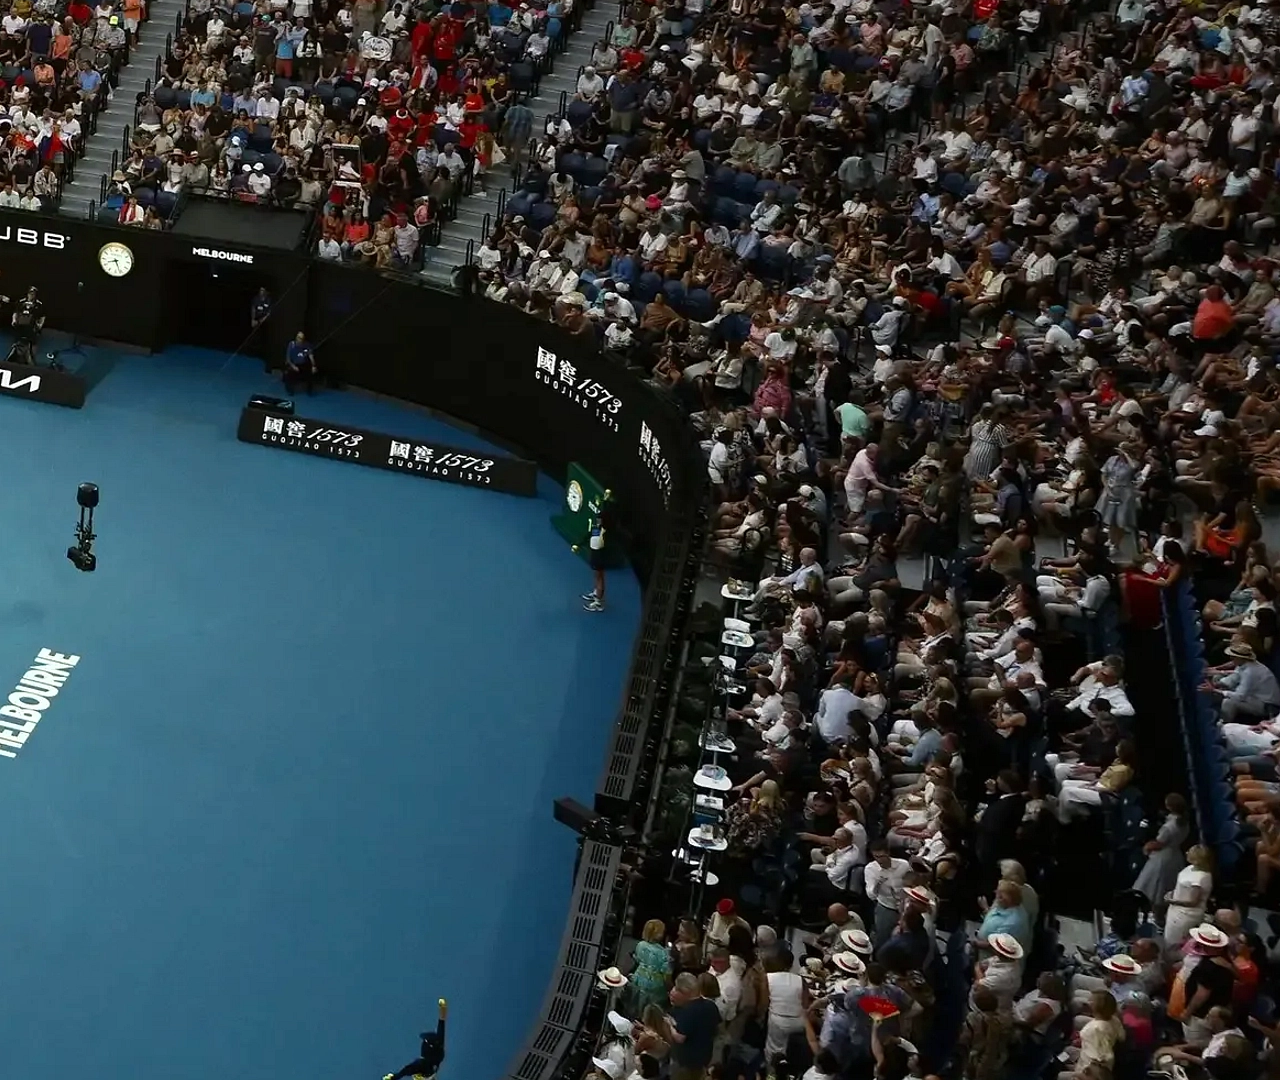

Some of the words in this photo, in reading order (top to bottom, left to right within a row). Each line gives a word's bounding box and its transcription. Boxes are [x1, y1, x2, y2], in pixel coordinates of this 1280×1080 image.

[192, 247, 254, 264] MELBOURNE
[535, 370, 589, 409] GUOJIAO
[595, 408, 619, 433] 1573
[261, 433, 320, 450] GUOJIAO
[329, 446, 361, 459] 1573
[387, 457, 449, 476] GUOJIAO
[458, 471, 491, 485] 1573
